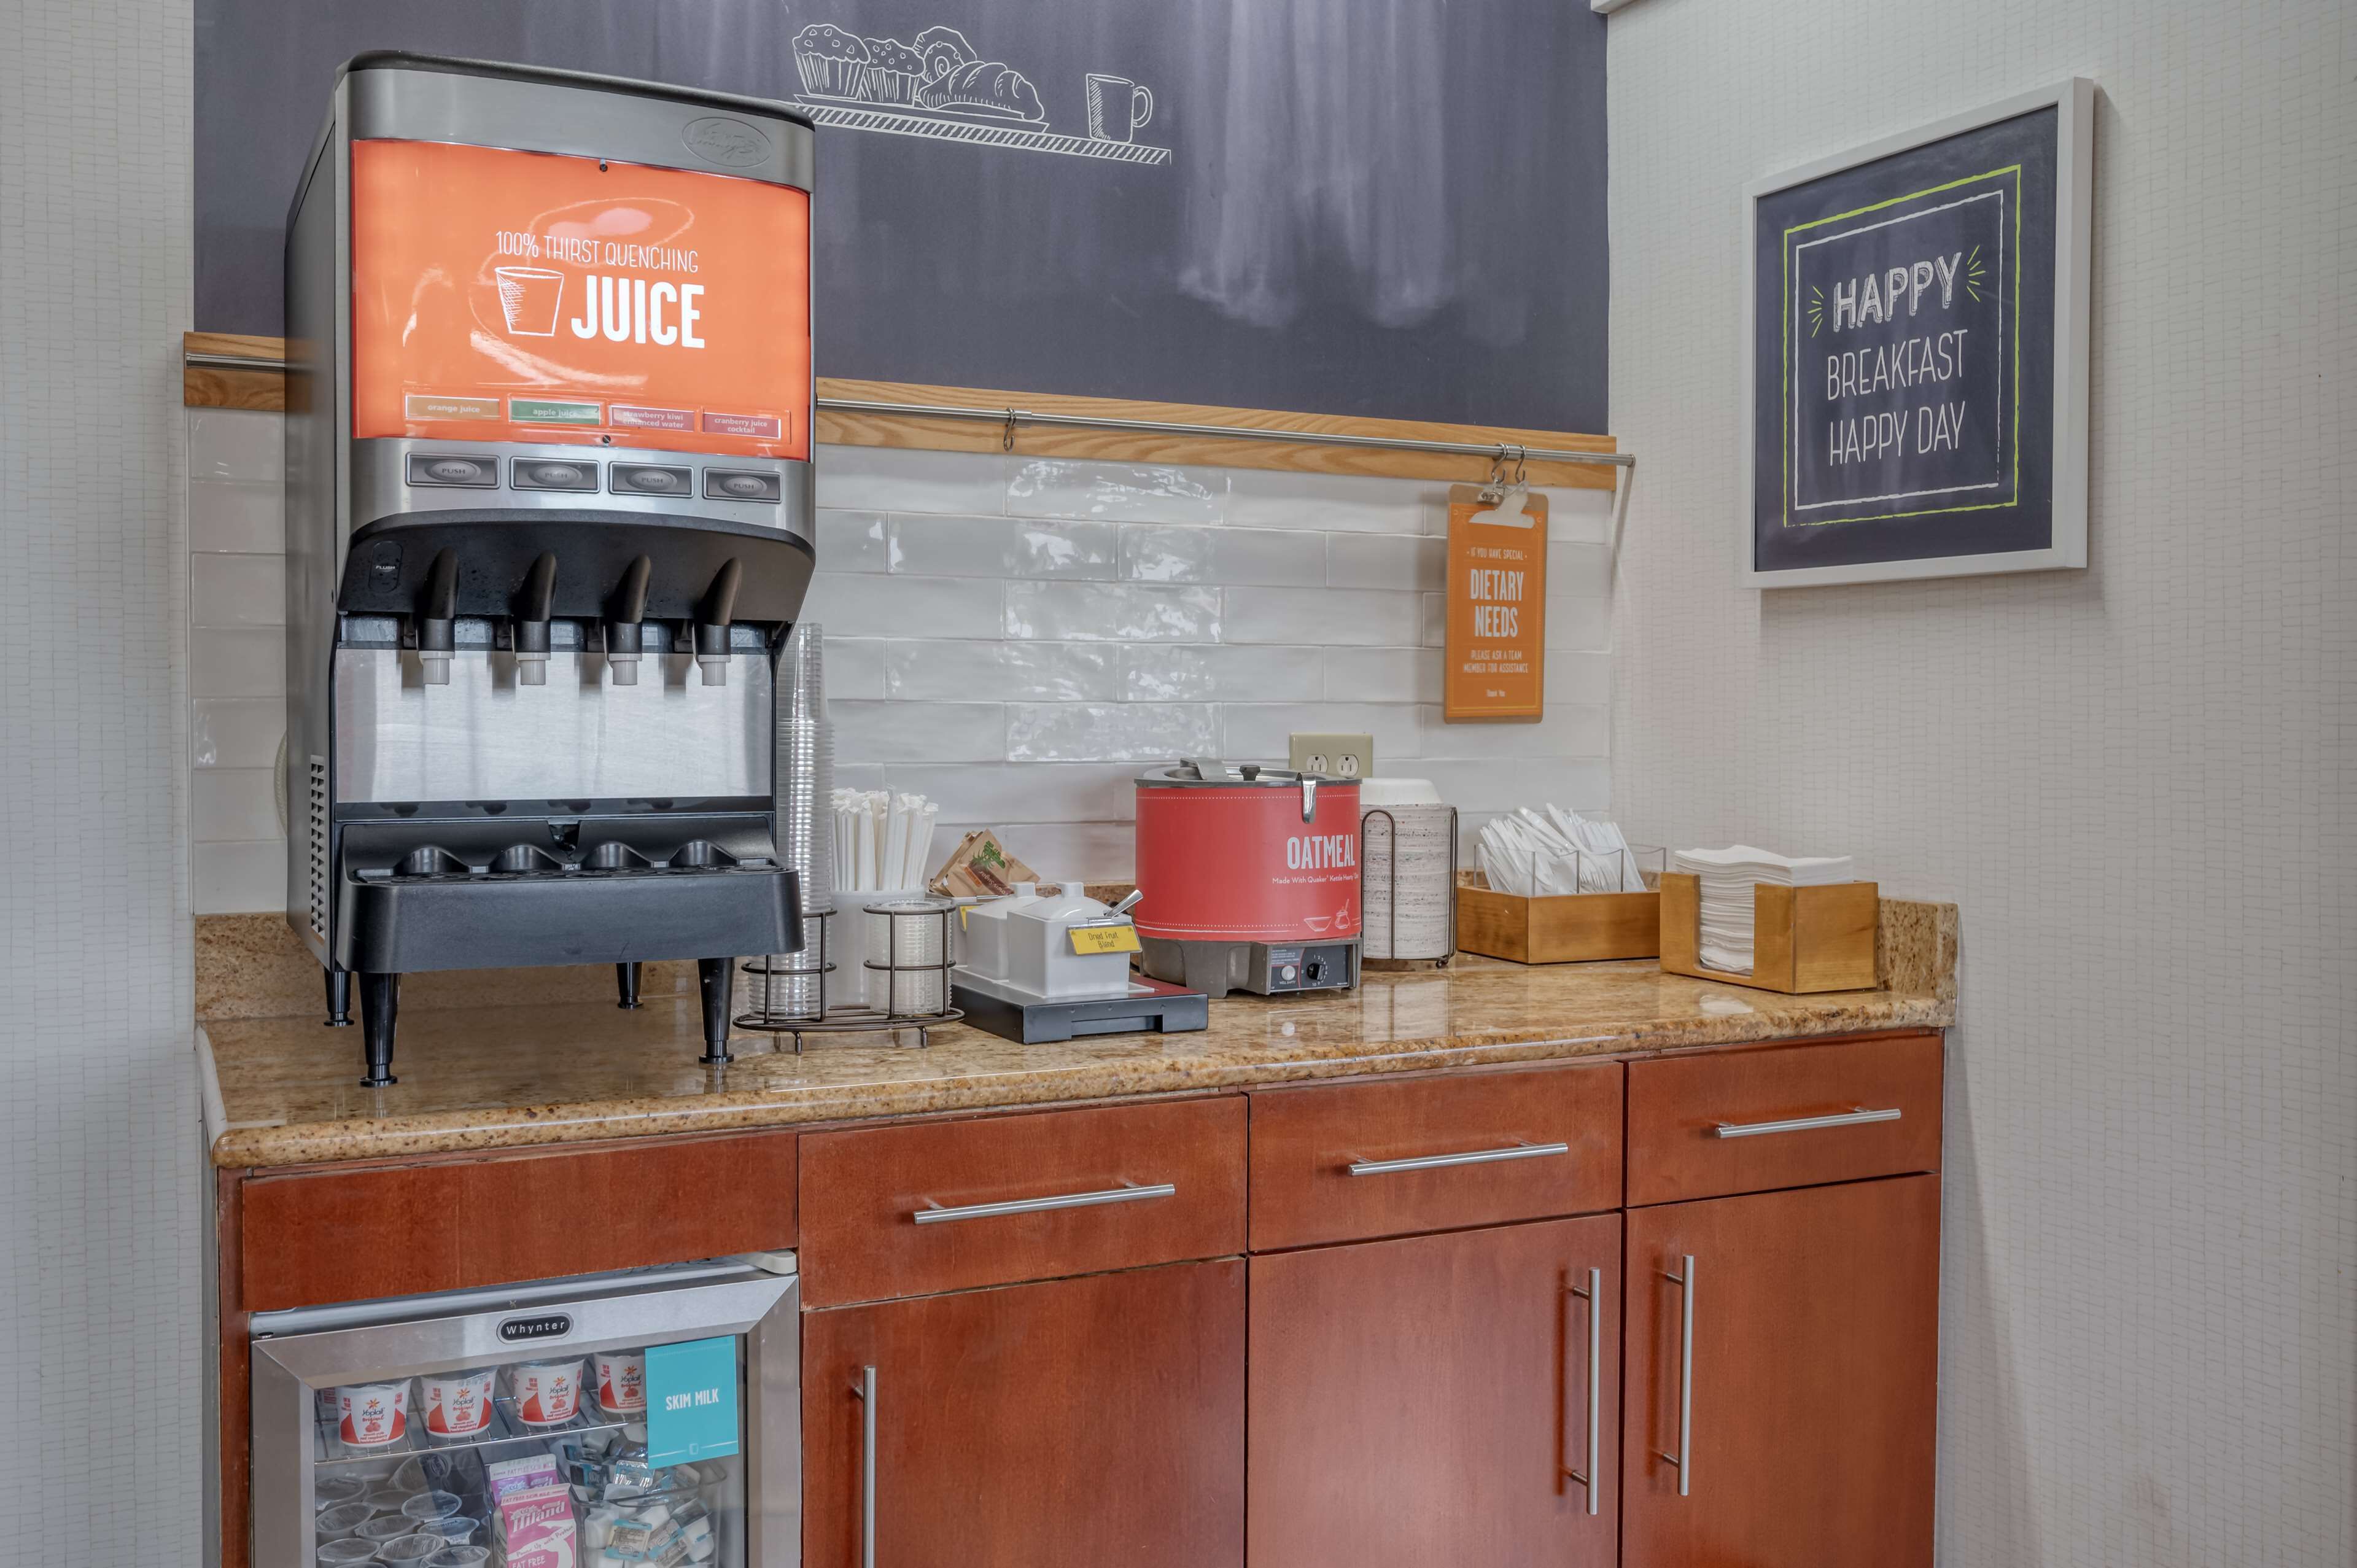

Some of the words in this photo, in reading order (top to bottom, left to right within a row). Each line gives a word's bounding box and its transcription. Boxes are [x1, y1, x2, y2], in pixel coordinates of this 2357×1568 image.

[496, 231, 538, 258] 100%
[544, 235, 600, 263] THIRST
[605, 243, 698, 273] QUENCHING
[1833, 252, 1962, 333] HAPPY
[571, 275, 705, 349] JUICE
[1828, 329, 1968, 400] BREAKFAST
[427, 405, 457, 413] orange
[460, 405, 480, 413] juice
[533, 408, 556, 417] apple
[558, 409, 578, 417] juice
[624, 411, 665, 421] strawberry
[623, 418, 659, 427] enhanced
[714, 417, 749, 427] cranberry
[750, 420, 767, 429] juice
[1830, 410, 1908, 466] HAPPY
[1918, 400, 1965, 454] DAY
[1477, 548, 1487, 557] YOU
[1489, 548, 1502, 559] HAVE
[1503, 549, 1523, 560] SPECIAL
[1470, 569, 1524, 601] DIETARY
[1475, 605, 1518, 638] NEEDS
[1470, 650, 1490, 660] PLEASE
[1493, 650, 1502, 660] ASK
[1509, 650, 1522, 660] TEAM
[1463, 663, 1486, 673] MEMBER
[1499, 663, 1528, 673] ASSISTANCE
[1287, 834, 1355, 869] OATMEAL
[1098, 940, 1115, 949] Blend
[507, 1321, 564, 1335] Whynter
[549, 1384, 569, 1394] Yoplait
[452, 1397, 474, 1406] Yoplait
[666, 1392, 691, 1410] SKIM
[695, 1388, 719, 1406] MILK
[362, 1407, 384, 1417] Yoplait
[511, 1502, 565, 1532] Hiland
[528, 1556, 545, 1567] FREE
